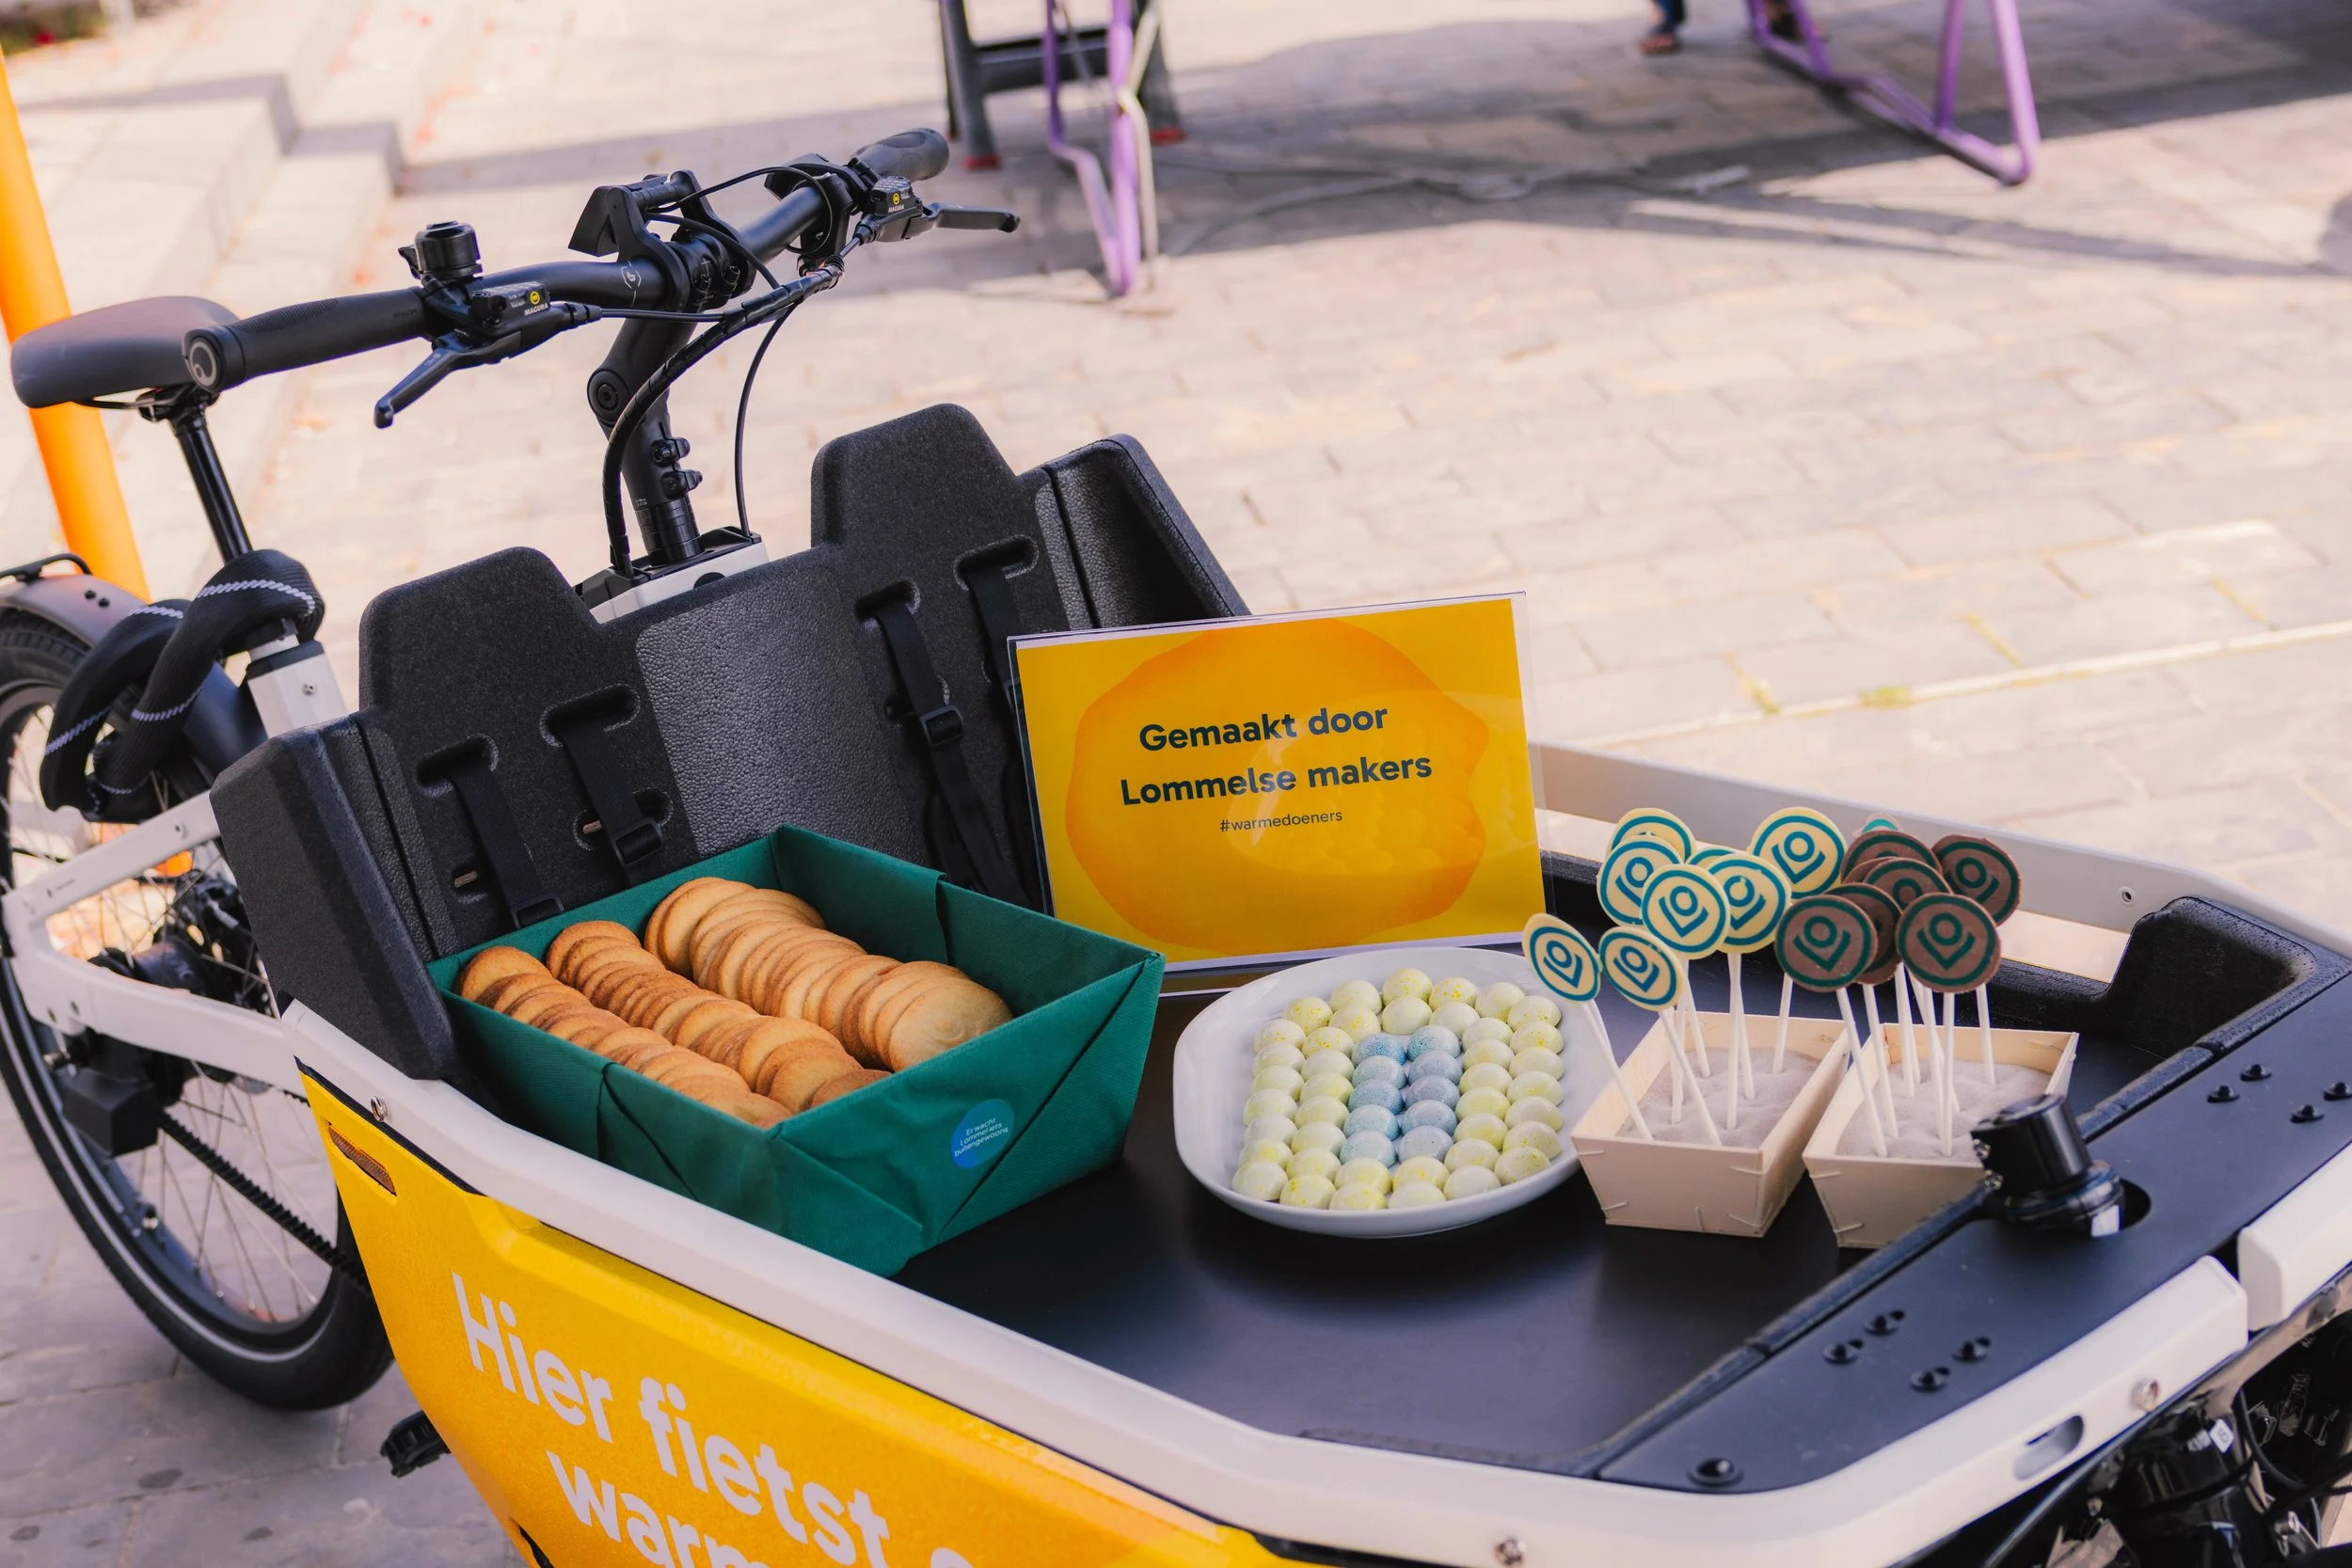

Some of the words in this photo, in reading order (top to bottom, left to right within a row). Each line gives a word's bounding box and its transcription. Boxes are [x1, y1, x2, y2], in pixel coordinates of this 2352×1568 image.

[525, 303, 548, 316] MAGURA
[1139, 714, 1297, 752] Gemaakt
[1309, 708, 1388, 736] door
[1120, 768, 1296, 806] Lommelse
[1309, 757, 1432, 787] makers
[1220, 811, 1343, 832] #warmedoeners
[453, 1273, 612, 1443] Hier
[640, 1377, 889, 1568] fietst
